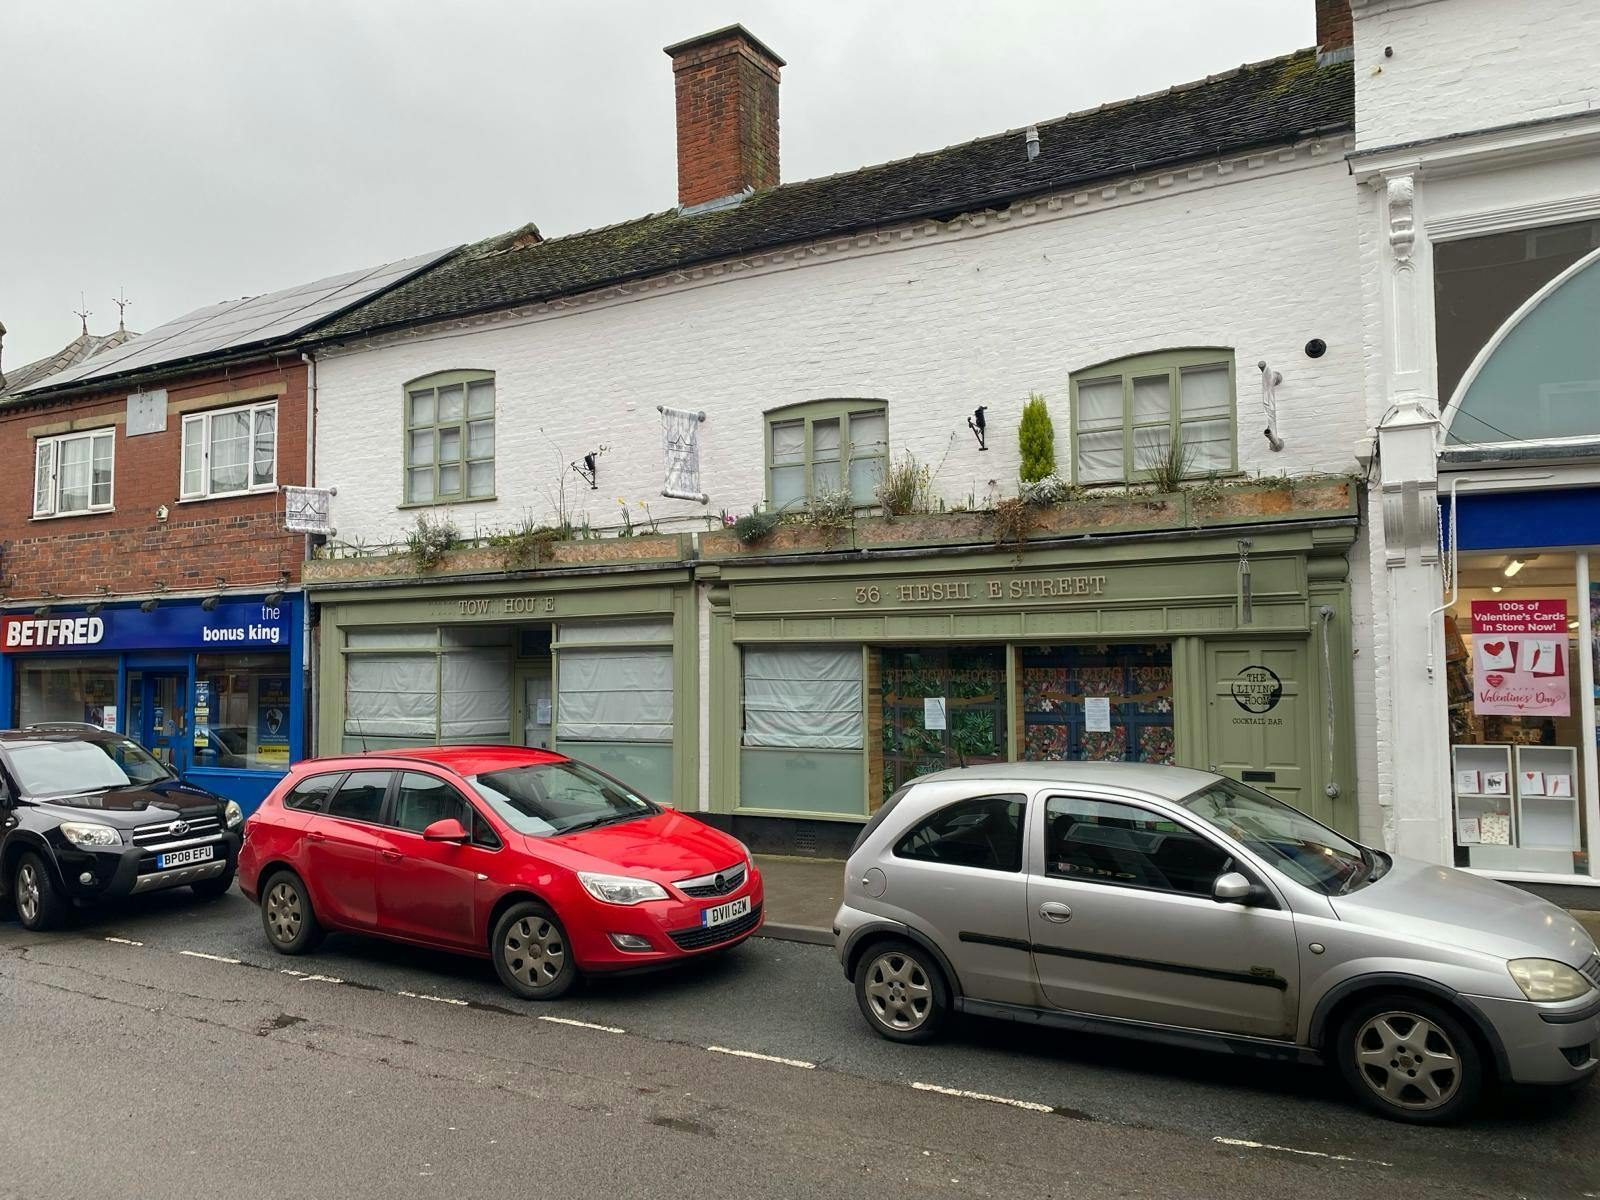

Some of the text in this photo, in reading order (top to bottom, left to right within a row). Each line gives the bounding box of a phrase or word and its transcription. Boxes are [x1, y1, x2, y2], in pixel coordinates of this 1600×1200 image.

[855, 585, 881, 603] 36
[1009, 575, 1106, 599] STREET
[261, 605, 280, 620] the
[458, 596, 555, 616] TOW HOU E
[1498, 602, 1540, 611] 100s of
[1473, 612, 1566, 622] Valentine's Cards
[6, 616, 105, 647] BETFRED
[203, 624, 280, 644] bonus king
[1483, 622, 1557, 632] In Store Now!
[1247, 673, 1266, 682] THE
[1233, 717, 1283, 726] COCKTAIL BAR
[164, 847, 211, 865] BP08 EFU
[712, 898, 747, 922] DV11 GZW
